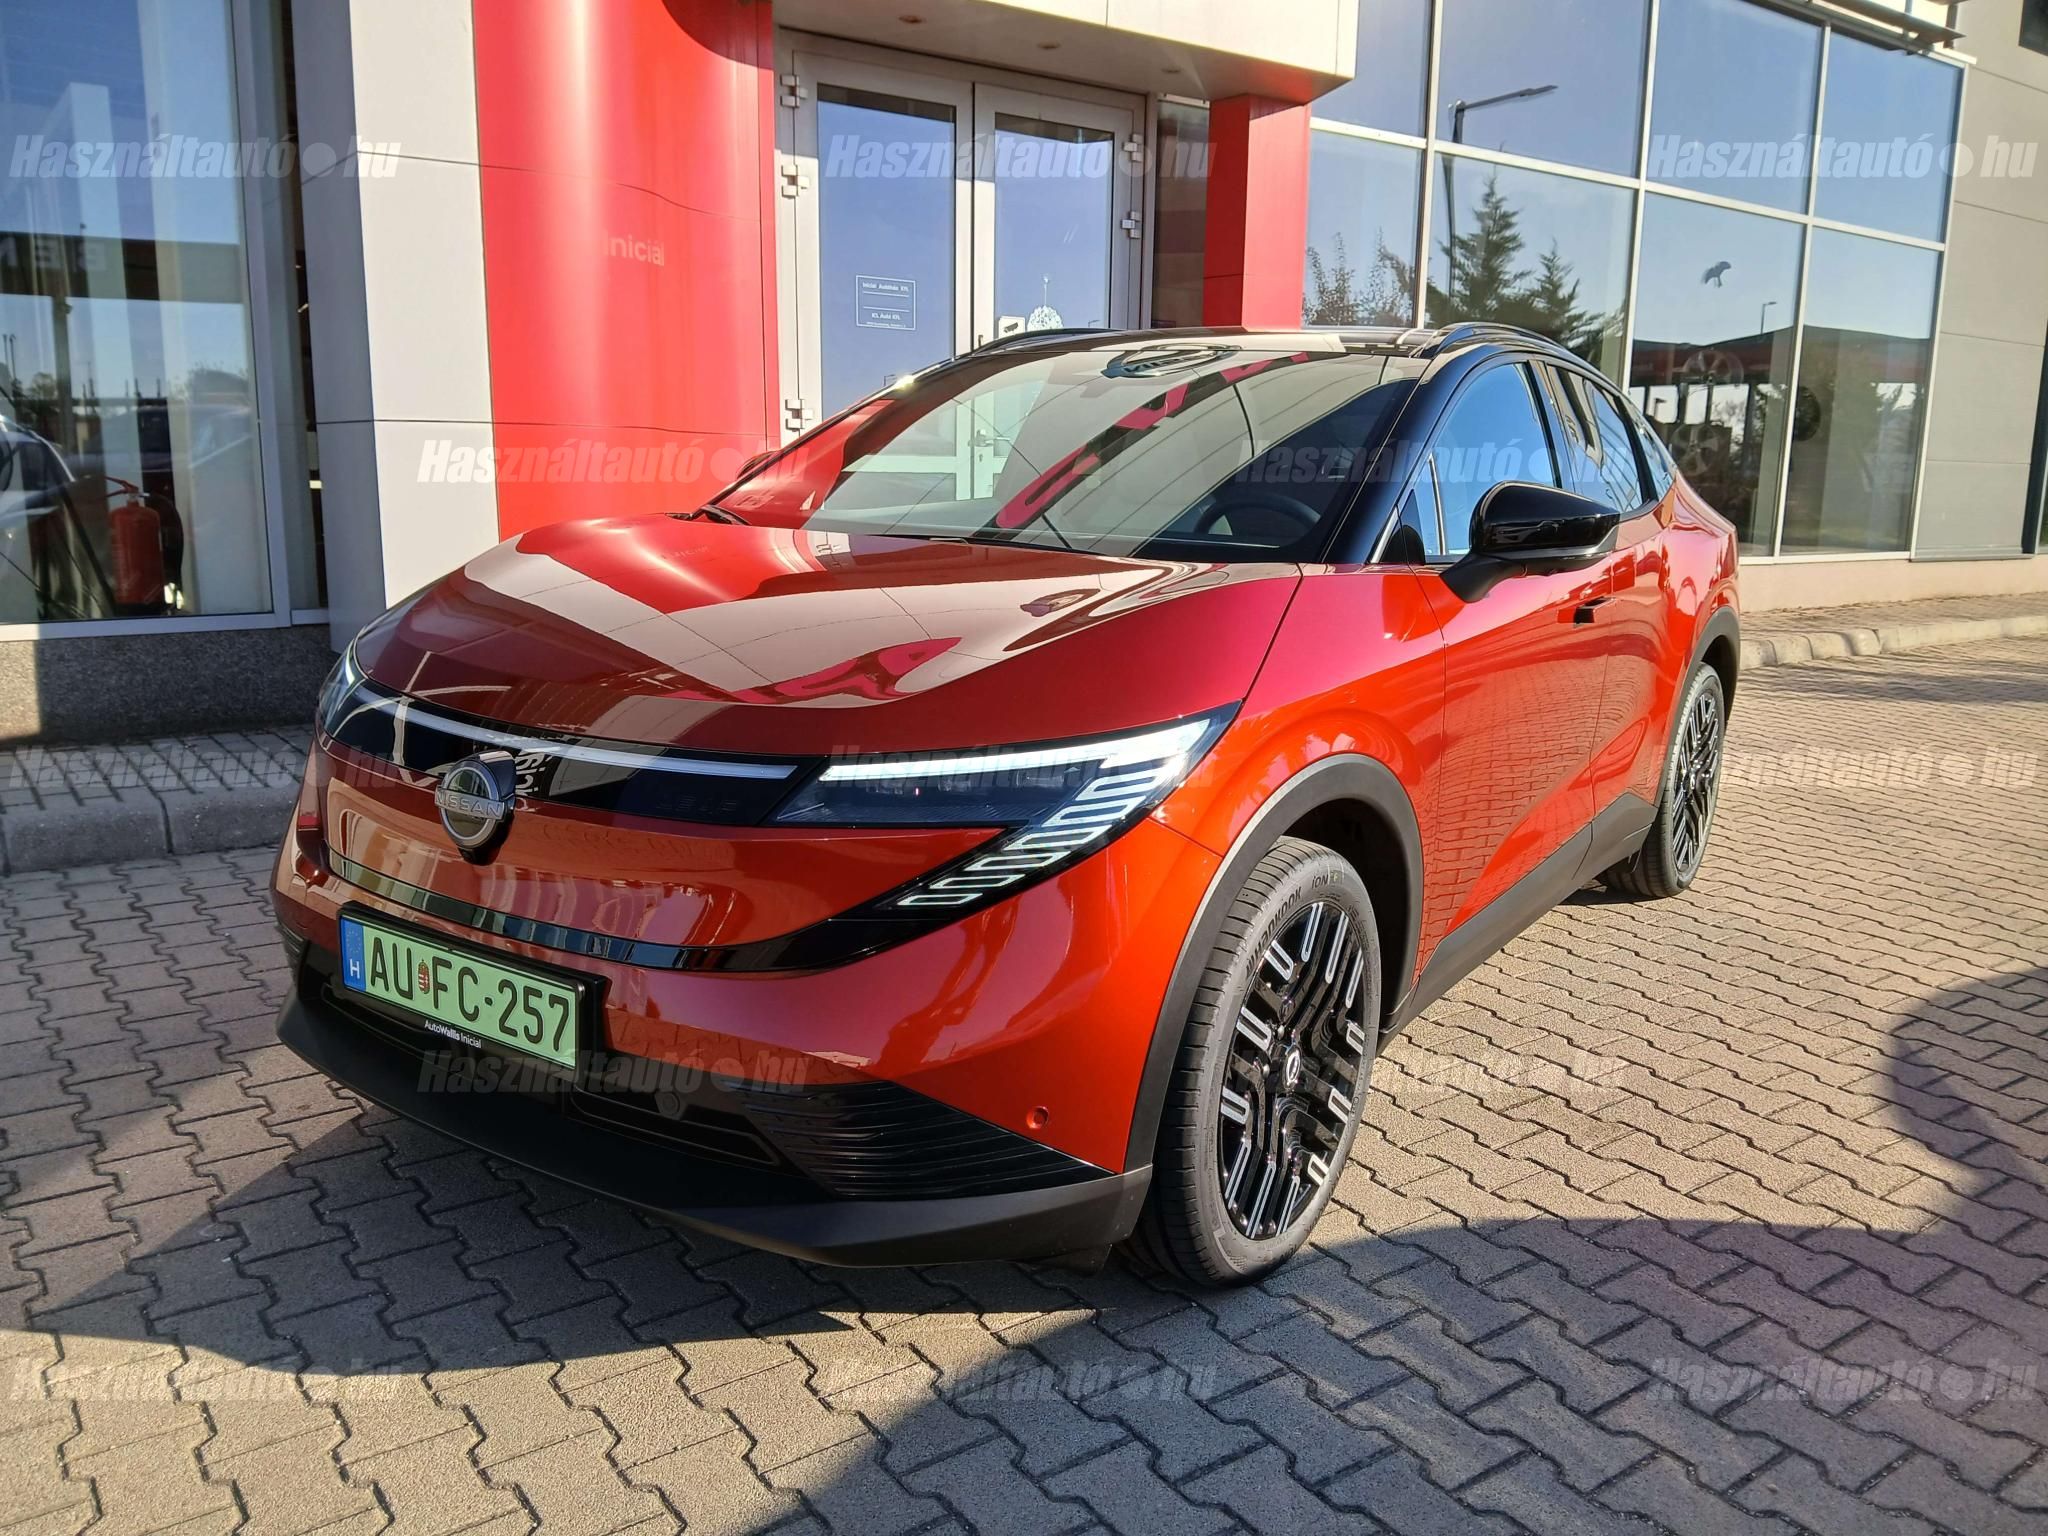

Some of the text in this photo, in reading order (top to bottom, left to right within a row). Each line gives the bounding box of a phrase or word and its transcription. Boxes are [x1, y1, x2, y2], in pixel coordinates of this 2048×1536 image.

[435, 791, 501, 817] NISSAN
[348, 958, 361, 980] H
[424, 1019, 461, 1041] AutoWallis
